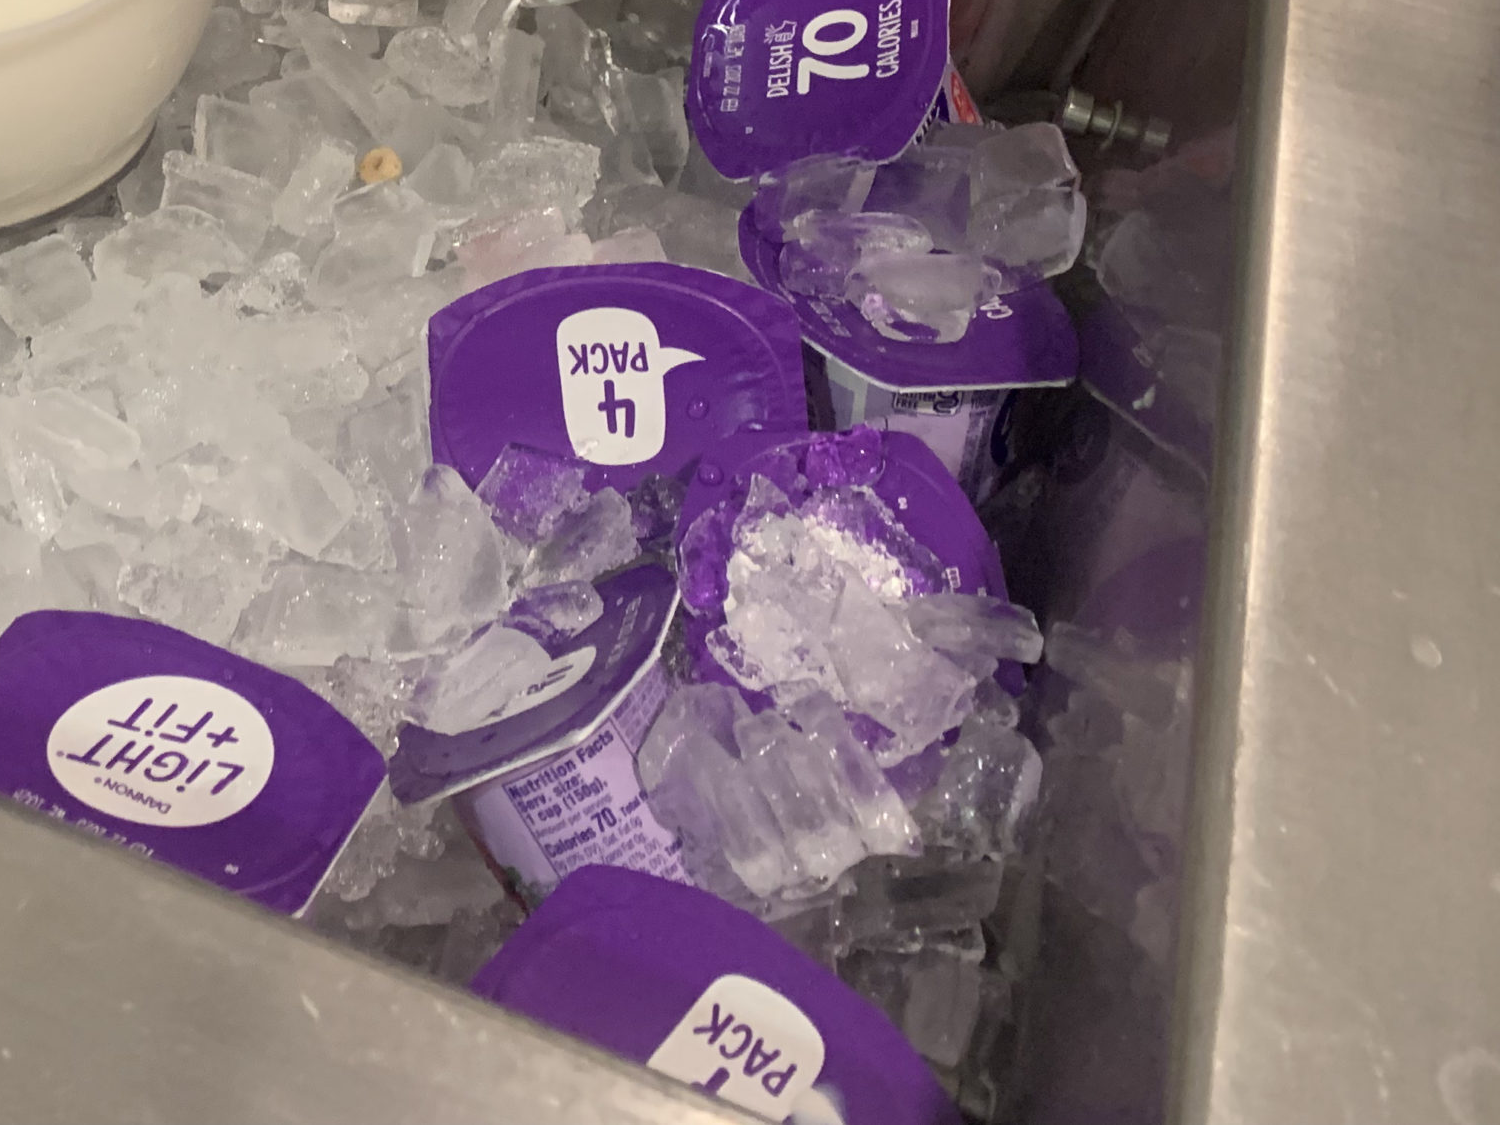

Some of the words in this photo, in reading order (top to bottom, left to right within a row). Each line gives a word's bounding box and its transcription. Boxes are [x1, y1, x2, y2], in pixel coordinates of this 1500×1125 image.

[766, 43, 792, 97] DELISH
[796, 8, 869, 94] 70
[567, 342, 650, 375] PACK
[598, 380, 636, 439] 4
[509, 763, 577, 800] Nutrition
[575, 729, 614, 763] Facts
[103, 777, 171, 815] DANNON
[517, 791, 552, 813] Serv.
[551, 773, 584, 797] size:
[525, 813, 535, 825] 1
[536, 802, 563, 822] cup
[543, 824, 597, 859] Calories
[620, 796, 641, 816] Total
[693, 1003, 797, 1097] PACK
